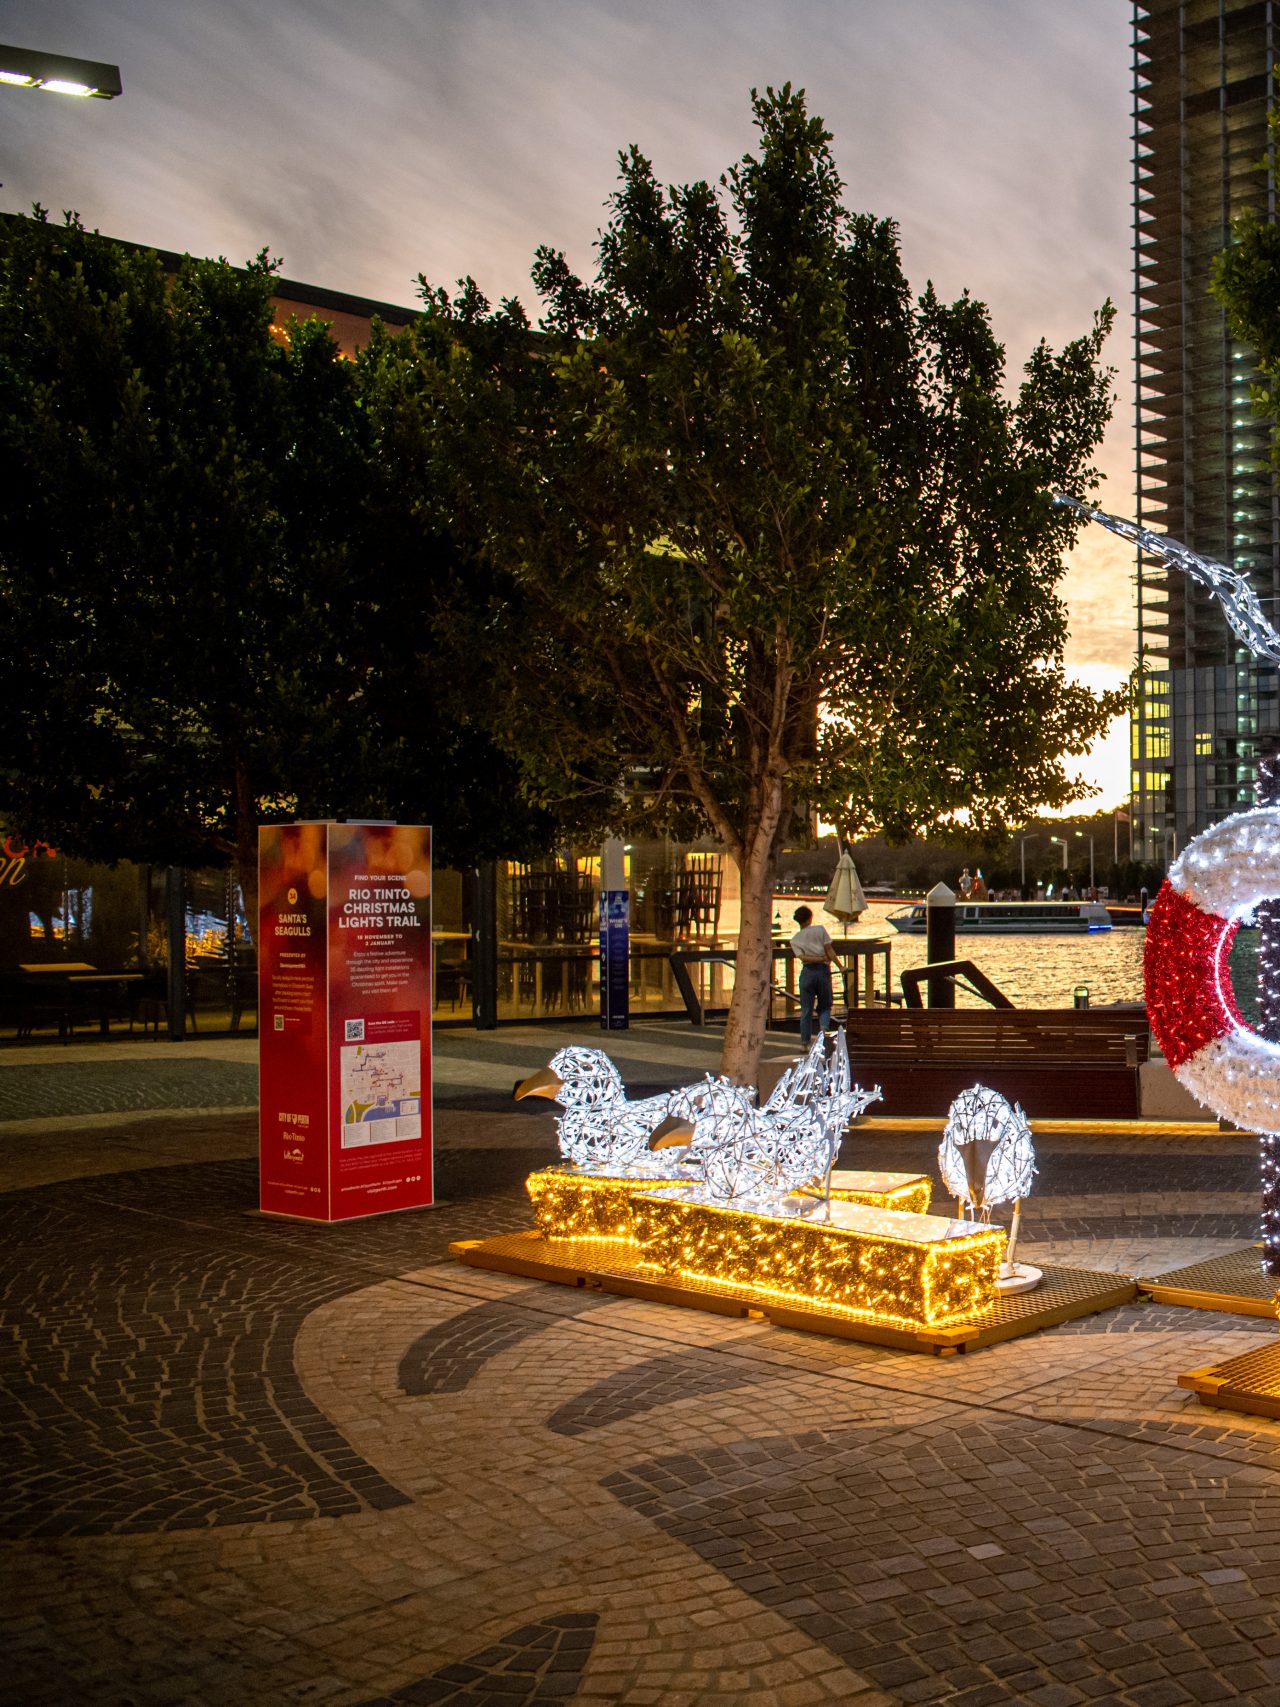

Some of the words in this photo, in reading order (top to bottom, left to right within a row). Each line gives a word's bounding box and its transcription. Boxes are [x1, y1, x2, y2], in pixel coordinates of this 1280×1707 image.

[349, 888, 371, 900] RIO
[373, 888, 411, 899] TINTO
[343, 902, 416, 914] CHRISTMAS
[278, 914, 307, 924] SANTA'S
[338, 916, 384, 929] LIGHTS
[386, 915, 421, 927] TRAIL
[274, 926, 311, 937] SEAGULLS
